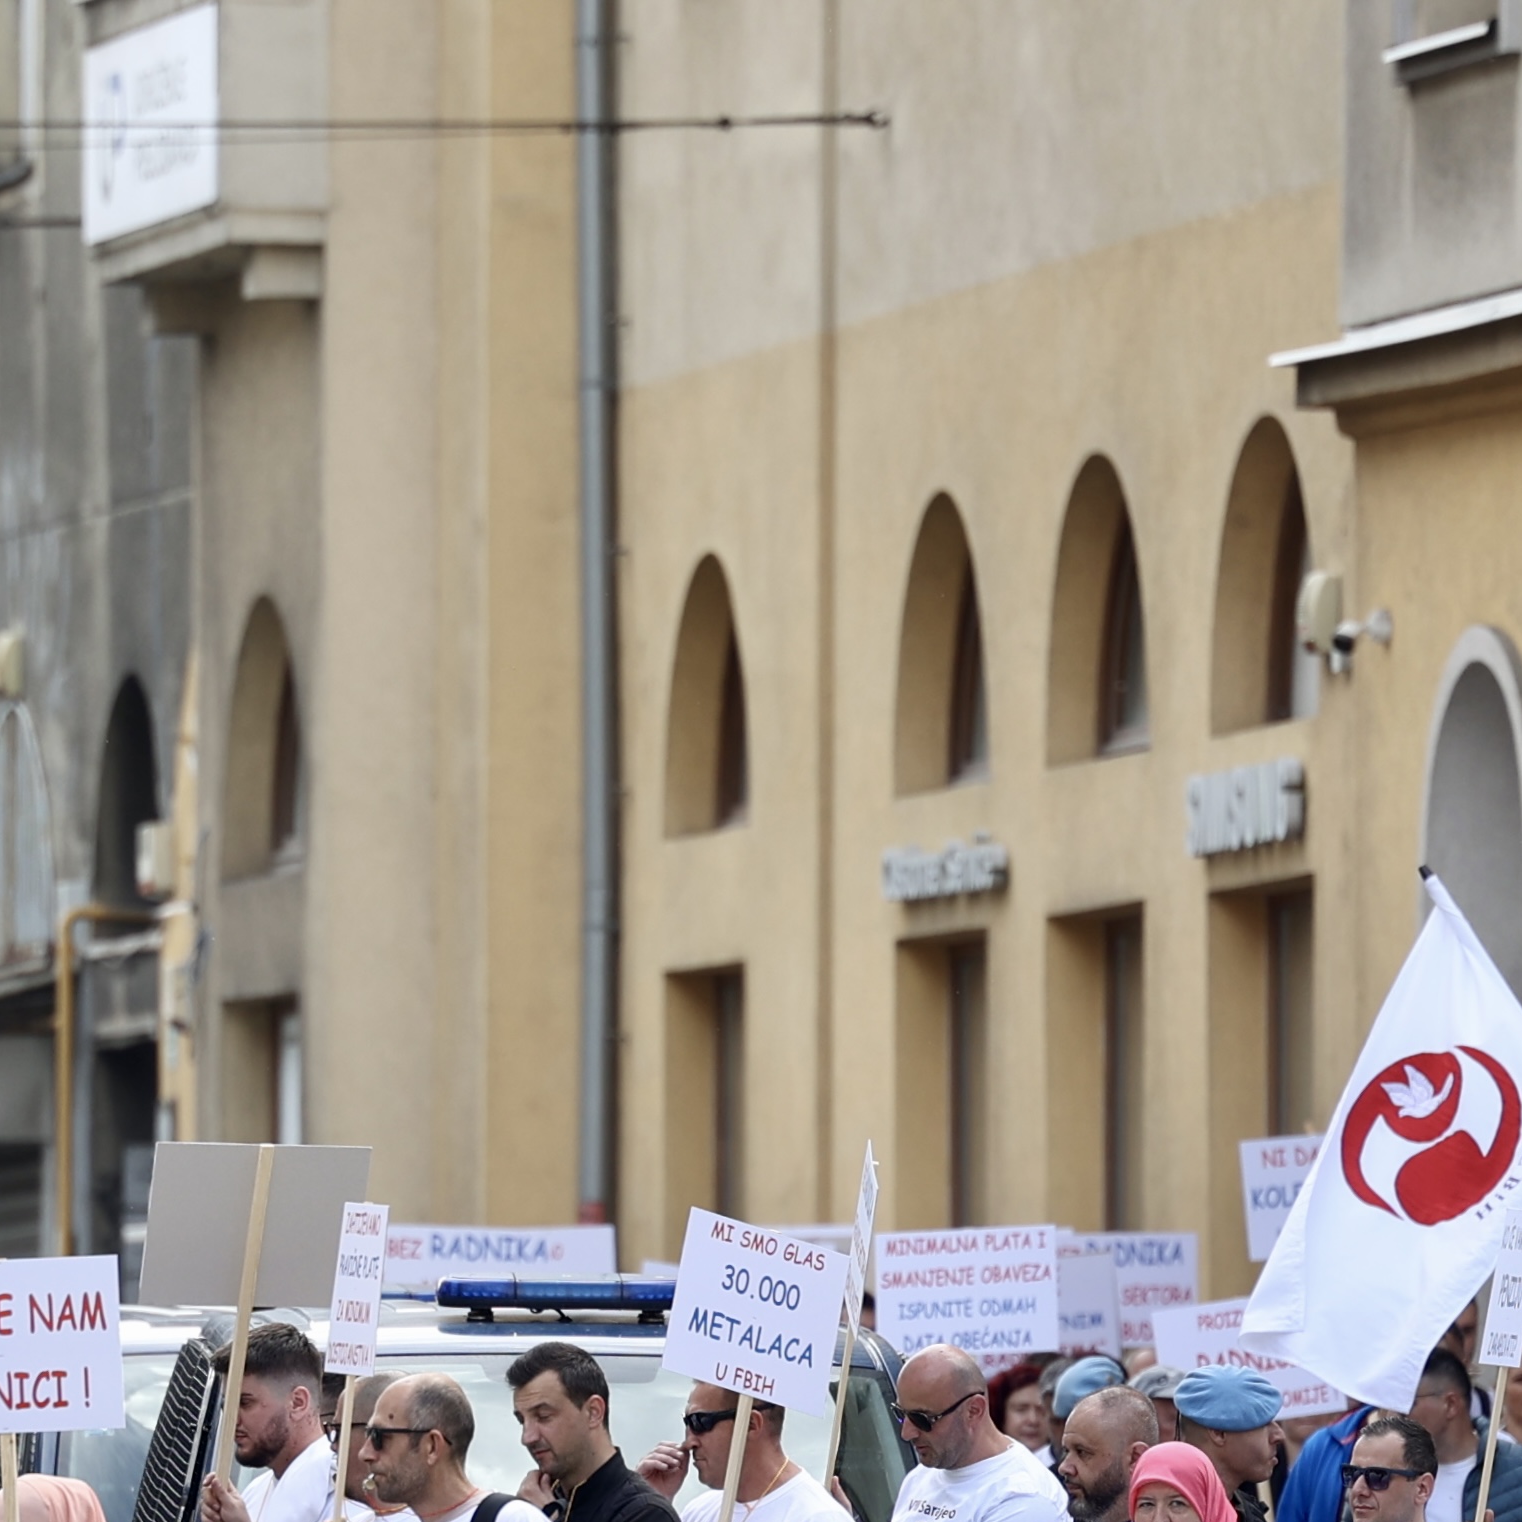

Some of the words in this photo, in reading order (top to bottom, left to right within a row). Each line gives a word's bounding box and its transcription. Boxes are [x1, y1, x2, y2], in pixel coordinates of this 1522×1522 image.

[1262, 1147, 1286, 1168] NI
[387, 1238, 423, 1260] BEZ
[431, 1233, 549, 1264] RADNIKA
[711, 1220, 735, 1243] MI
[739, 1231, 778, 1256] SMO
[783, 1243, 826, 1271] GLAS
[886, 1236, 978, 1257] MINIMALNA
[985, 1233, 1031, 1251] PLATA
[1037, 1232, 1046, 1249] I
[721, 1264, 801, 1310] 30.000
[880, 1267, 975, 1290] SMANJENJE
[981, 1264, 1052, 1284] OBAVEZA
[1122, 1285, 1192, 1305] SEKTORA
[29, 1290, 107, 1334] NAM
[898, 1299, 973, 1321] ISPUNITE
[979, 1297, 1037, 1317] ODMAH
[1197, 1309, 1244, 1330] PROIZ
[688, 1306, 813, 1368] METALACA
[951, 1326, 1032, 1351] OBEĆANJA
[1121, 1321, 1153, 1342] BUD
[83, 1366, 91, 1408] !
[715, 1362, 728, 1381] U
[732, 1367, 775, 1397] FBIH
[1282, 1384, 1328, 1408] OMIJE
